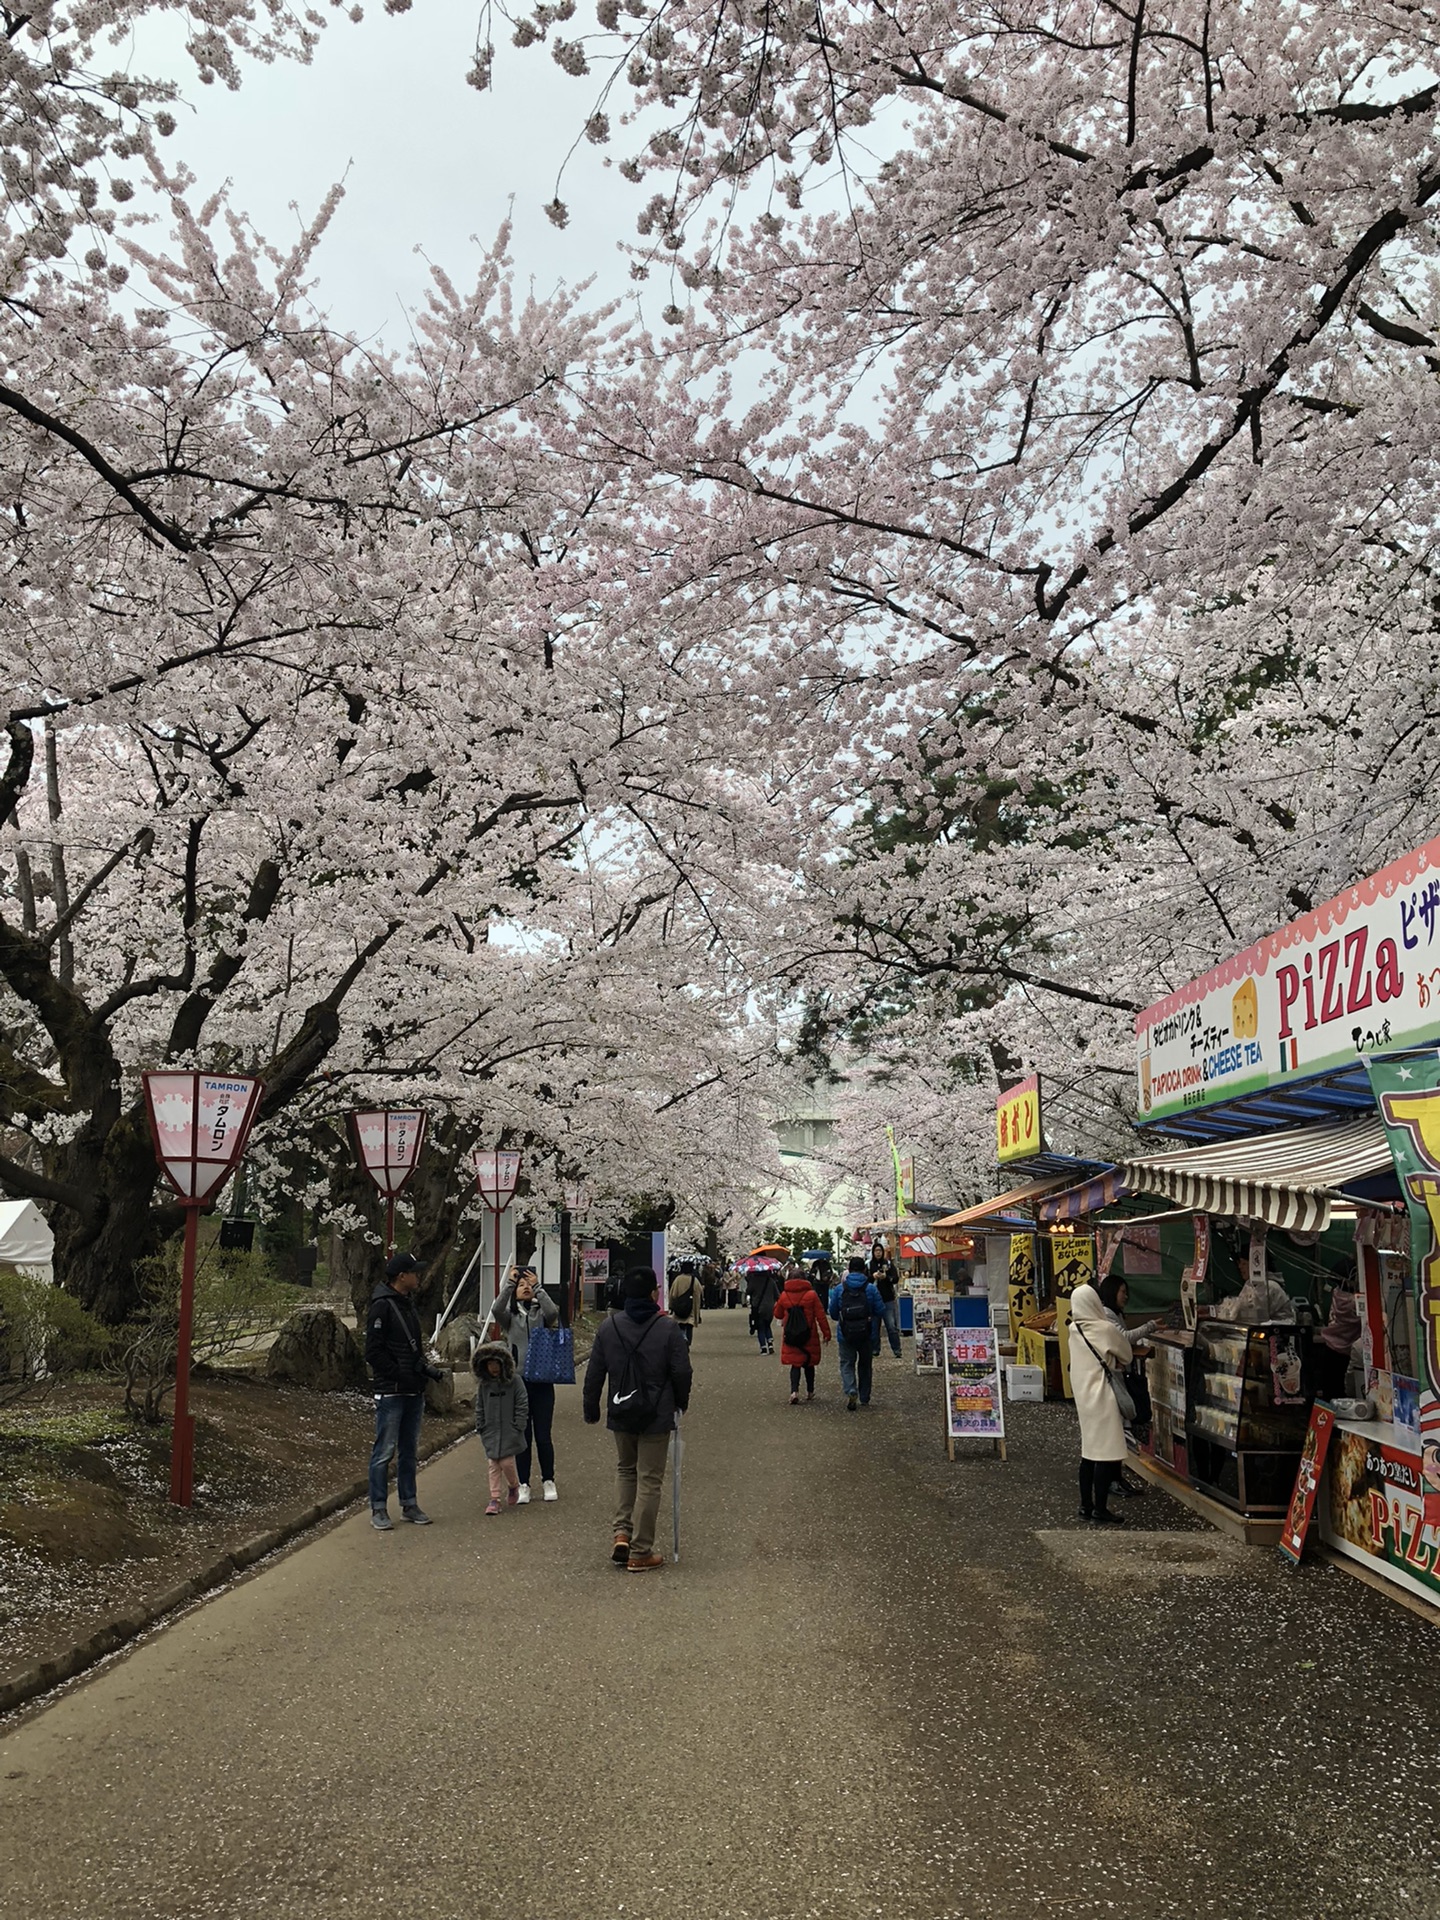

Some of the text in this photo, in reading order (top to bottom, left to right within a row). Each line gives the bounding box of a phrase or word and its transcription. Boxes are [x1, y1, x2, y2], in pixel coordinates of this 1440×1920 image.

[1276, 925, 1404, 1040] PiZZa
[1190, 1026, 1229, 1057] チーズティー
[1152, 1069, 1183, 1098] TAPIOCA
[1208, 1043, 1243, 1079] CHEESE
[1244, 1041, 1262, 1067] TEA
[205, 1082, 248, 1092] TAMRON
[211, 1106, 229, 1152] タムロン
[397, 1130, 406, 1161] タムロン
[956, 1345, 988, 1359] 甘酒
